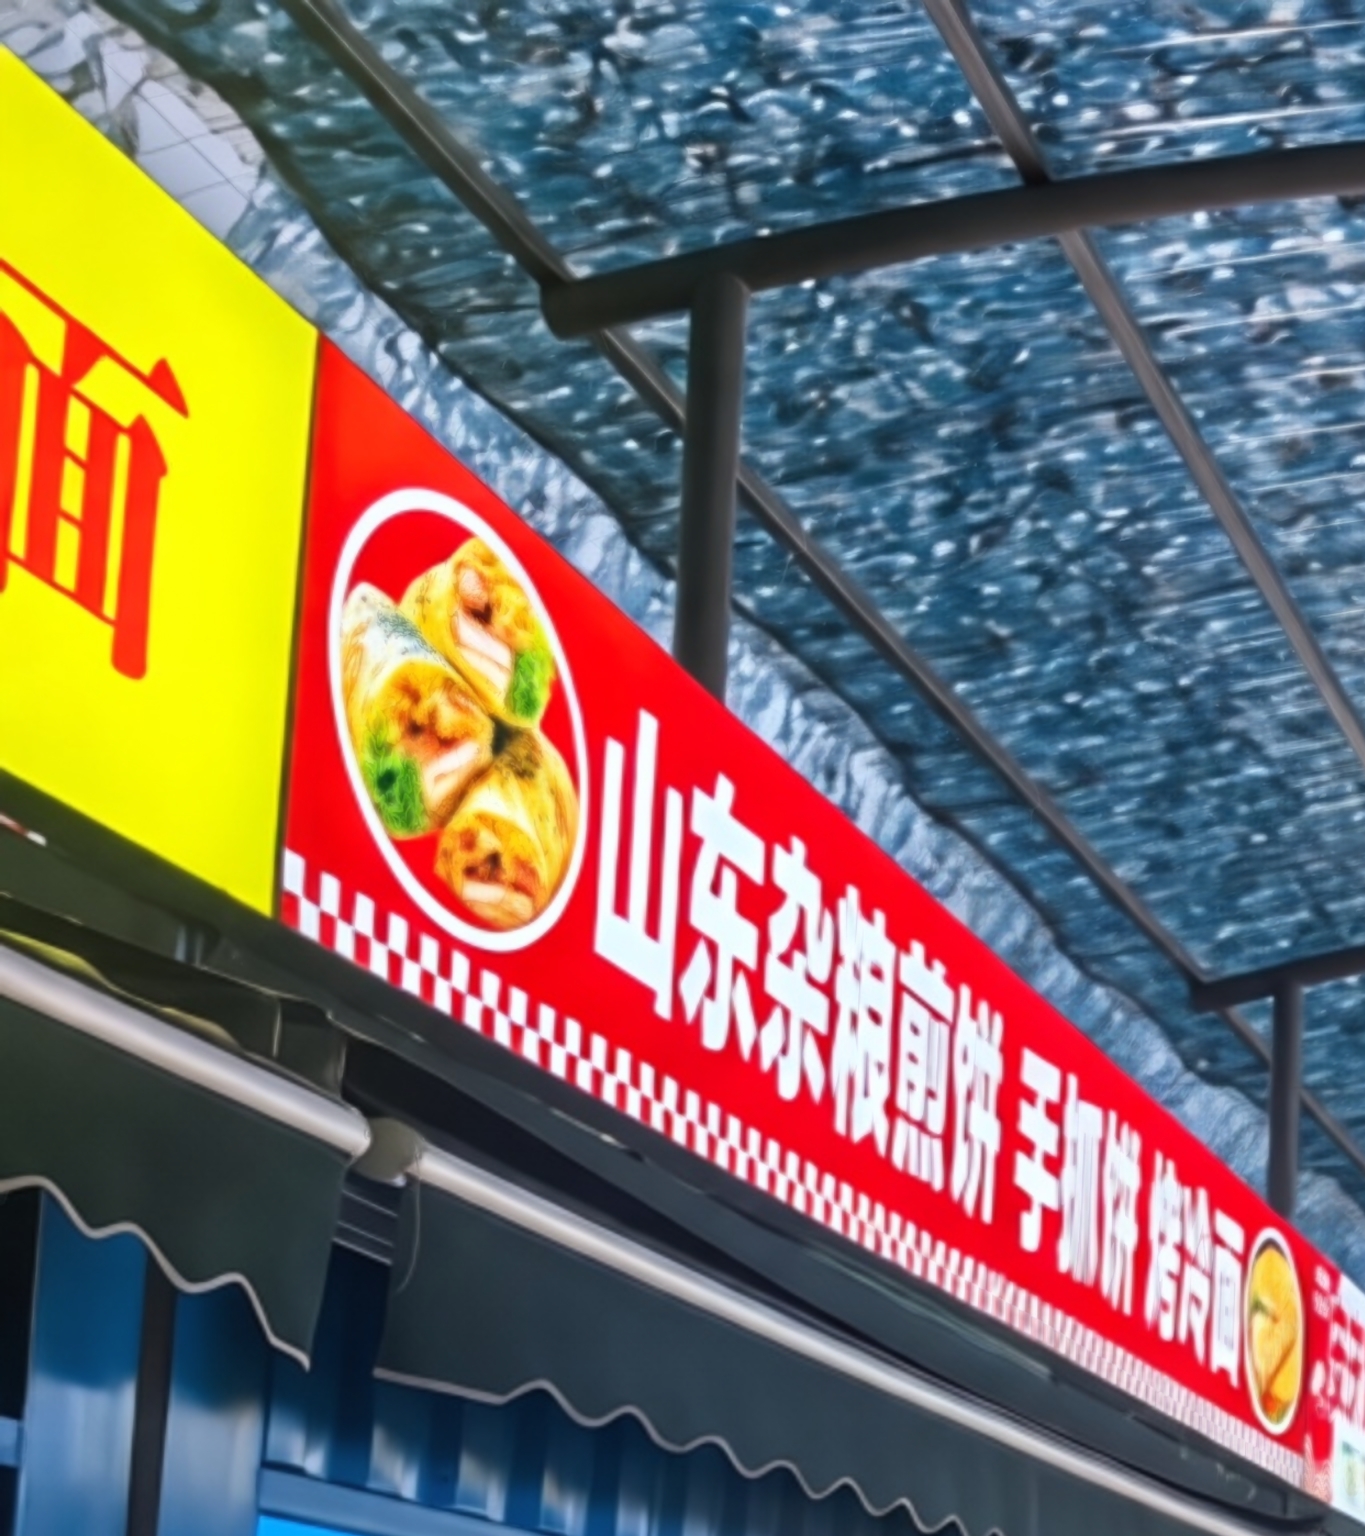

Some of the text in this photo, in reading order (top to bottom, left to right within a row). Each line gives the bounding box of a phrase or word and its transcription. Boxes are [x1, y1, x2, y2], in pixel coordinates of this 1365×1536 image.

[593, 707, 1245, 1387] 山东杂粮煎饼 手抓饼 烤冷面
